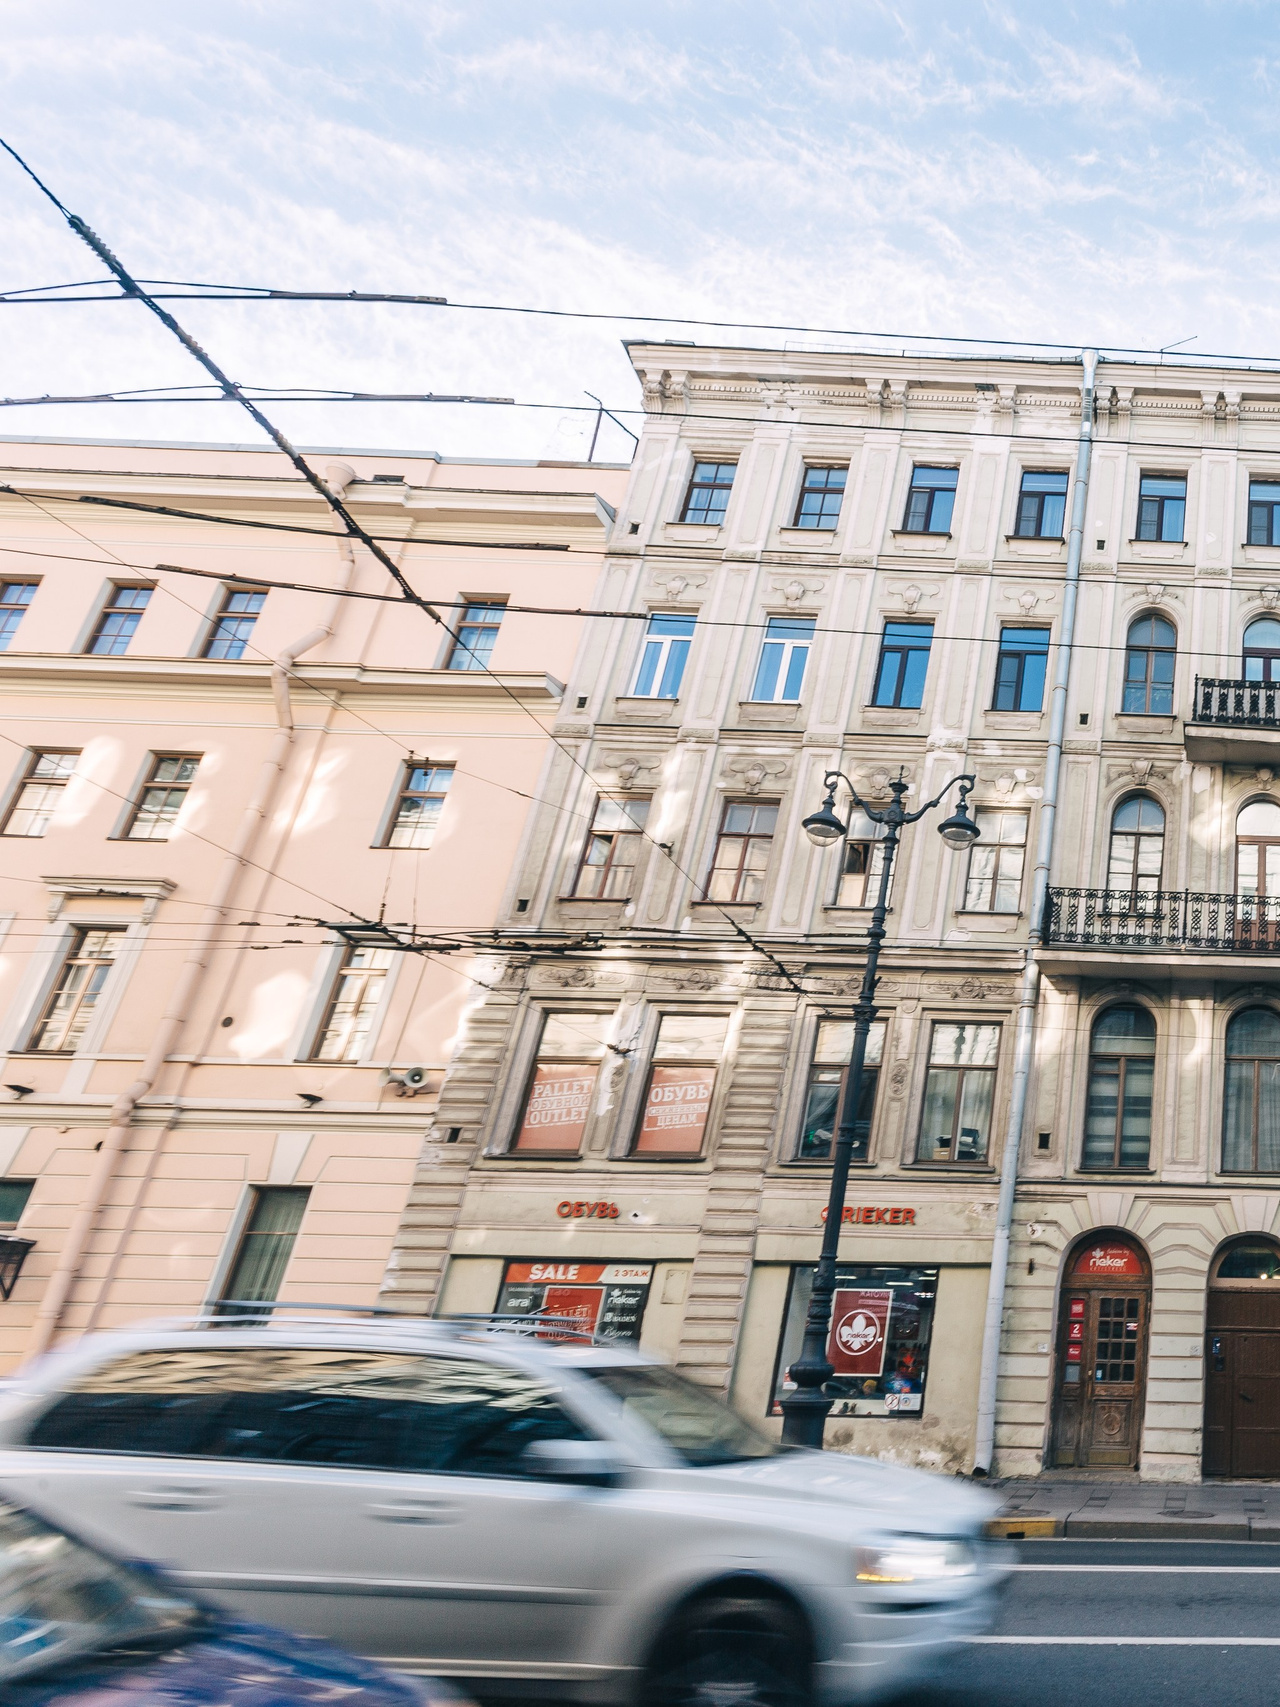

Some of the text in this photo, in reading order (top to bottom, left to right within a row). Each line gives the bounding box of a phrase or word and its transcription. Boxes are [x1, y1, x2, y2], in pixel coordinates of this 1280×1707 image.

[533, 1080, 591, 1098] PALLET
[651, 1084, 709, 1103] ОБУВЬ
[532, 1093, 590, 1111] ОБУВНОЙ
[529, 1107, 588, 1125] OUTLET
[657, 1113, 697, 1127] ЦЕНАМ
[556, 1201, 620, 1218] ОБУВЬ
[841, 1206, 916, 1225] RIEKER
[1089, 1255, 1128, 1267] rieker
[529, 1264, 650, 1281] SALE 2 ЭТАЖ
[1073, 1323, 1080, 1334] 2
